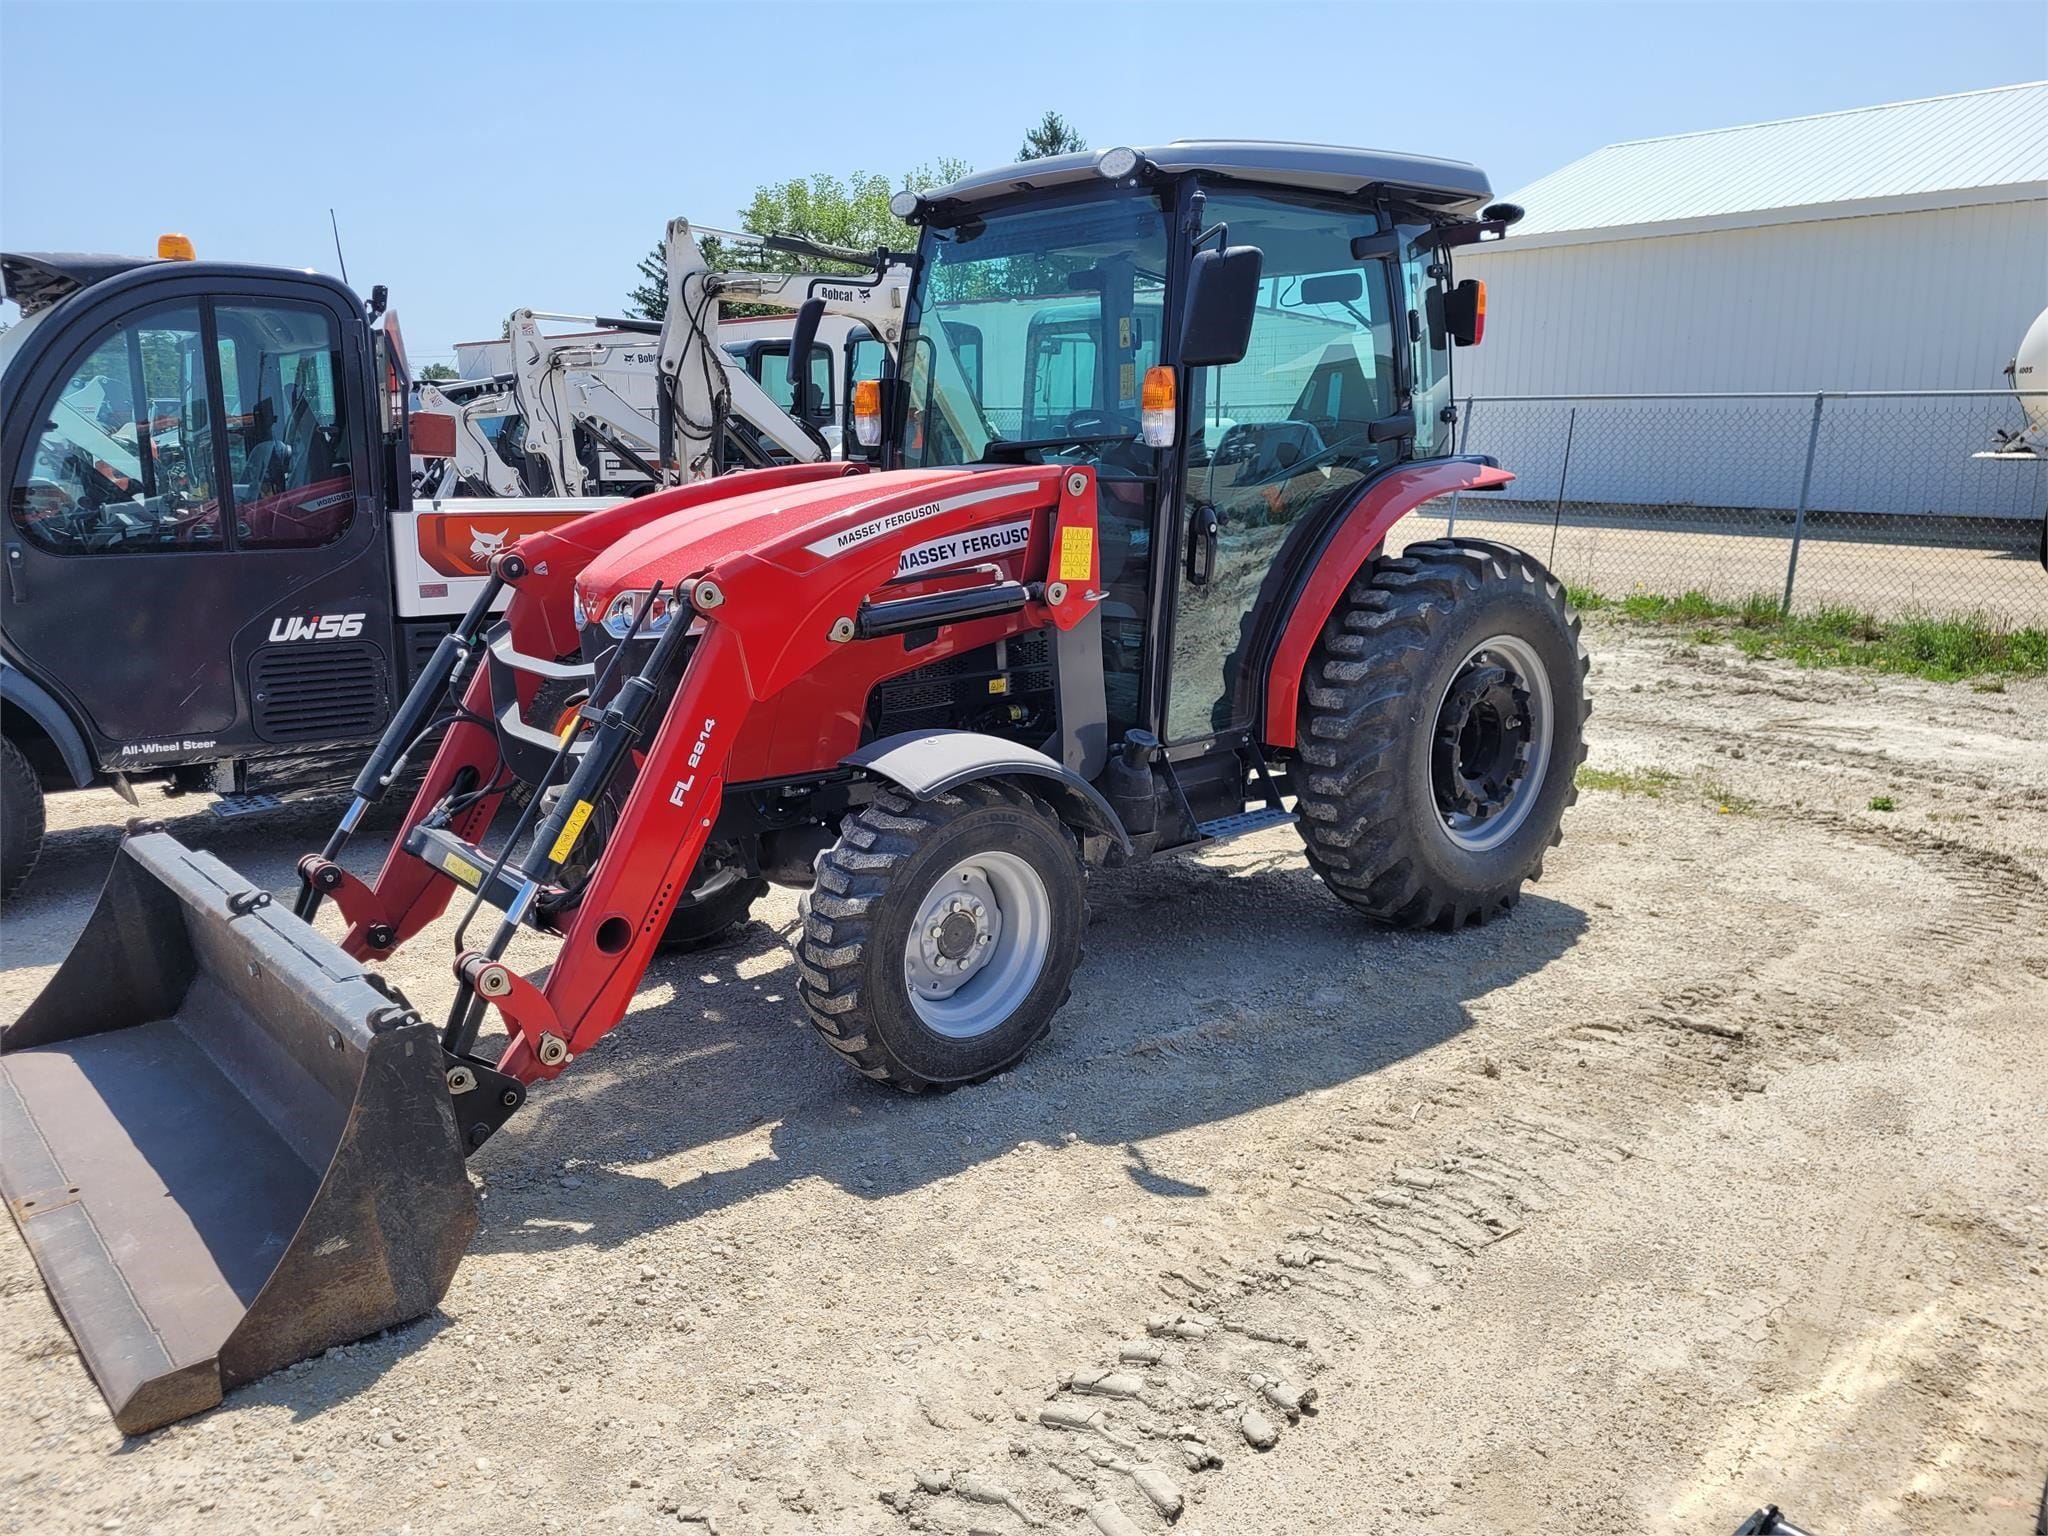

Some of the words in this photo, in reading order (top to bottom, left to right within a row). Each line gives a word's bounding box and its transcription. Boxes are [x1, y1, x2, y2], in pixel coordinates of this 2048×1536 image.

[821, 287, 853, 302] Bobcat
[837, 522, 881, 548] MASSEY
[885, 503, 940, 529] FERGUSON
[898, 542, 957, 571] MASSEY
[962, 526, 1030, 554] FERGUSO
[268, 613, 366, 642] UW56
[121, 741, 180, 756] All-Wheel
[183, 740, 217, 750] Steer
[669, 774, 695, 808] FL
[687, 718, 716, 769] 2814
